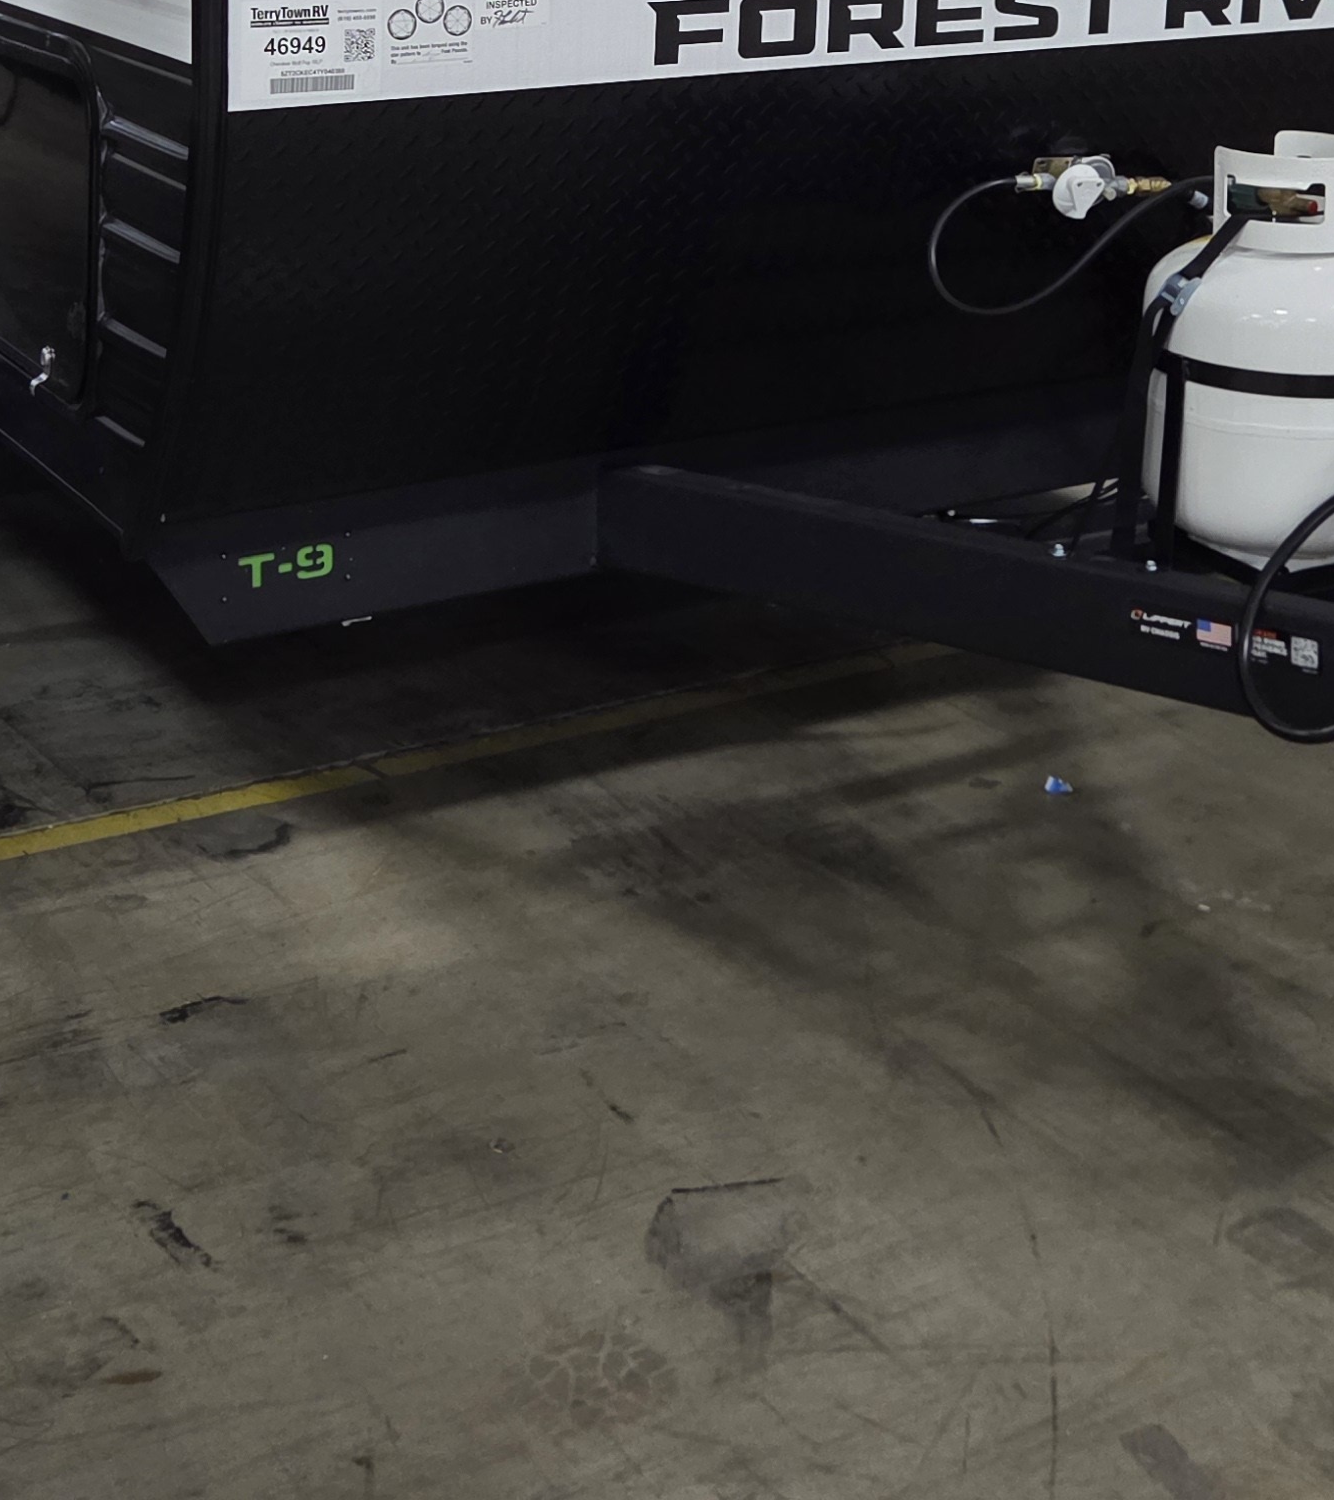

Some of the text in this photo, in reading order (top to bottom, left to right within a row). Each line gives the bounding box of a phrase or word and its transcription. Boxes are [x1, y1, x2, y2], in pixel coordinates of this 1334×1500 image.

[312, 4, 329, 18] RV
[480, 16, 493, 25] BY
[263, 36, 326, 56] 46949
[237, 543, 334, 589] T-9
